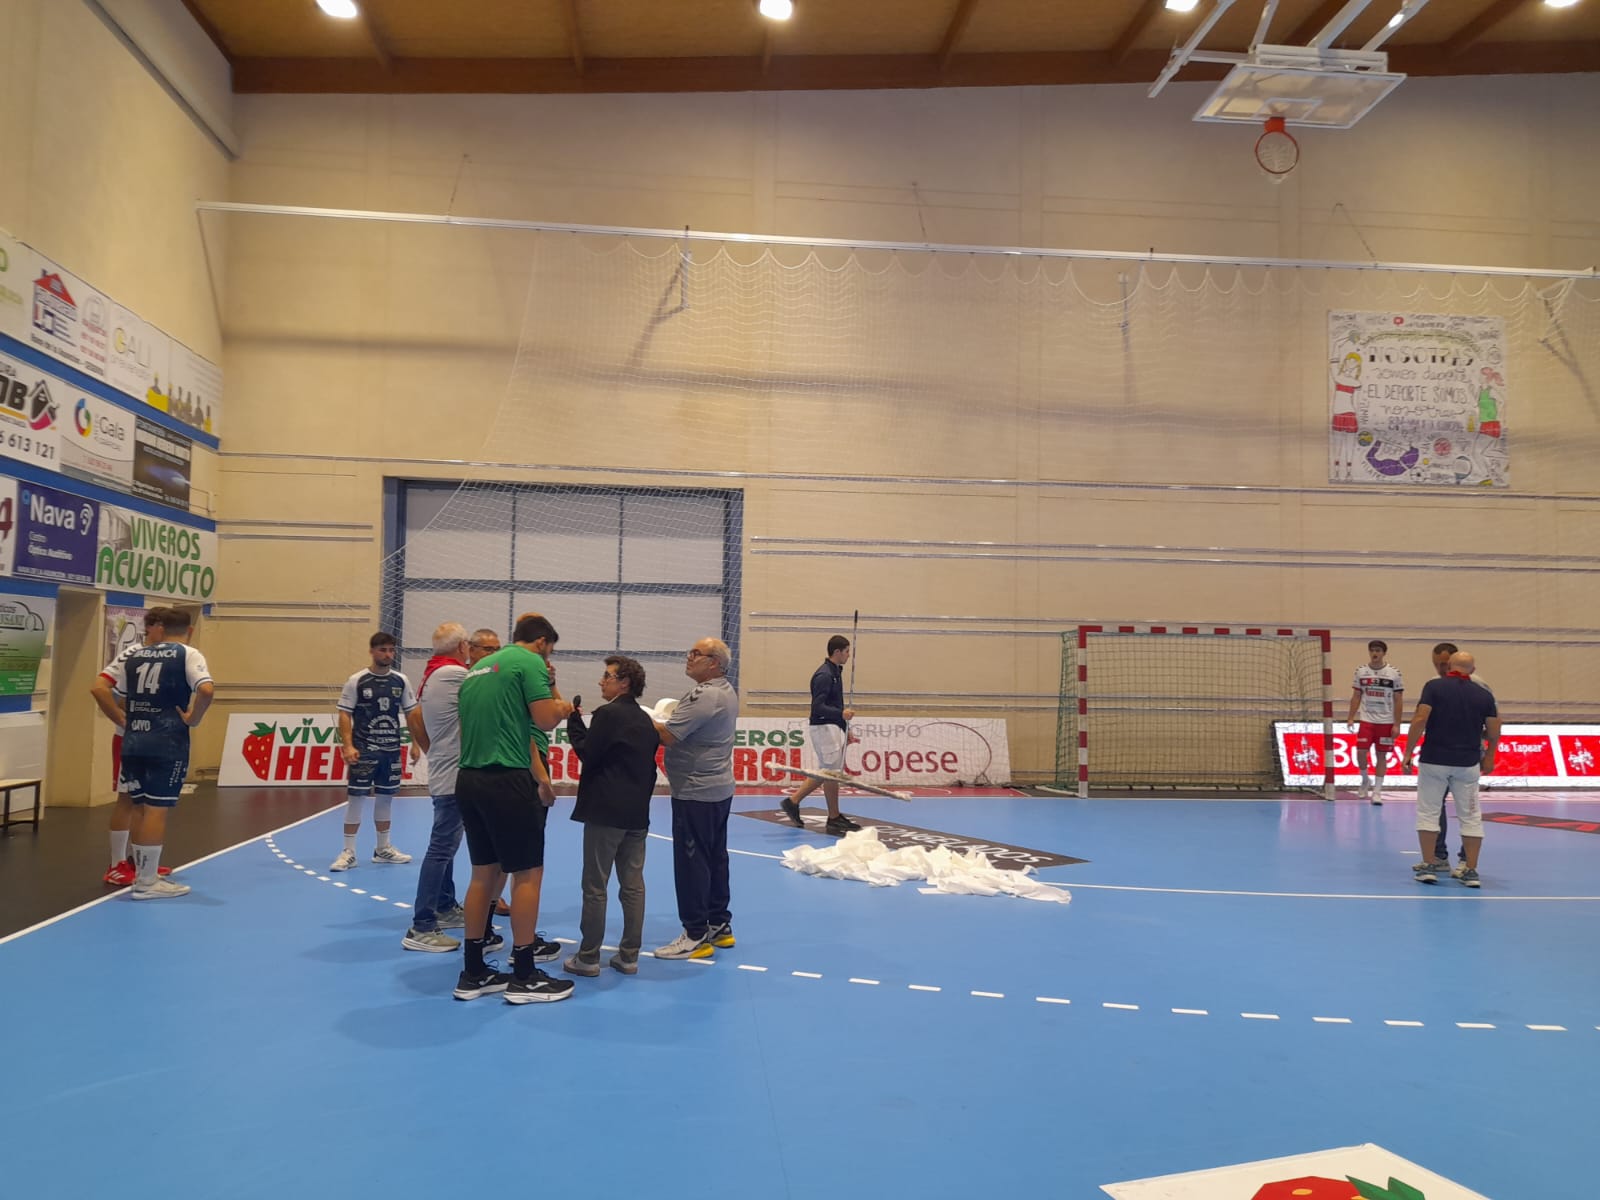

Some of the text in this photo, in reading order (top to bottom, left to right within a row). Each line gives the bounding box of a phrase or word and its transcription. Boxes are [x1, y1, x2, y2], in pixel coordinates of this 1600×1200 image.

[8, 433, 31, 452] 613
[35, 441, 55, 459] 121
[30, 494, 76, 530] Nava
[130, 515, 200, 561] VIVEROS
[96, 546, 214, 598] ACUEDUCTO
[133, 649, 177, 658] ABANCA
[135, 662, 162, 694] 14
[843, 750, 958, 781] Copese
